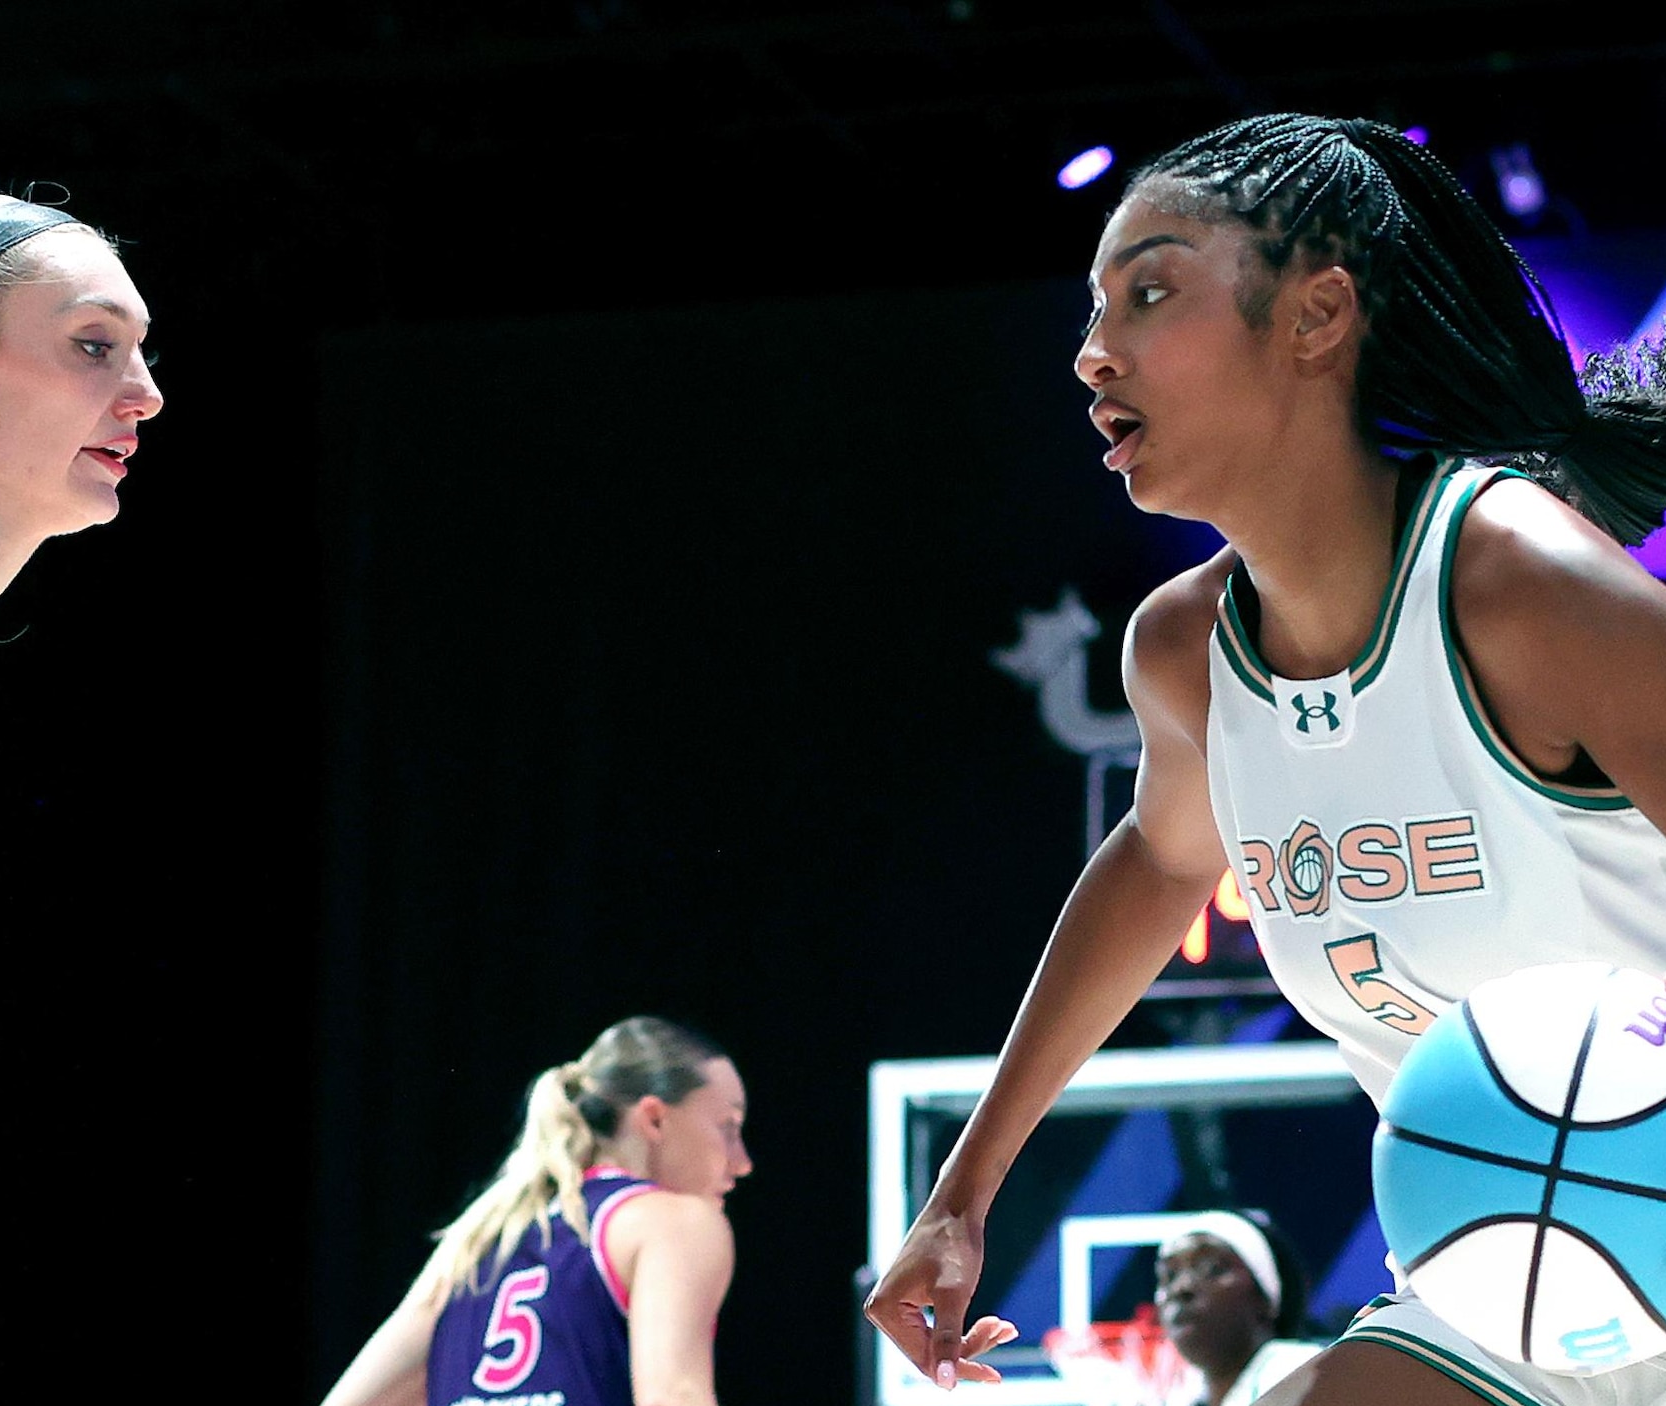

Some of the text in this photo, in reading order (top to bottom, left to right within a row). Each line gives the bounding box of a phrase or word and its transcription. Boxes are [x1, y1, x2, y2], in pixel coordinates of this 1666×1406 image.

[1240, 818, 1485, 917] ROSE
[1324, 933, 1437, 1036] 5
[471, 1264, 550, 1393] 5
